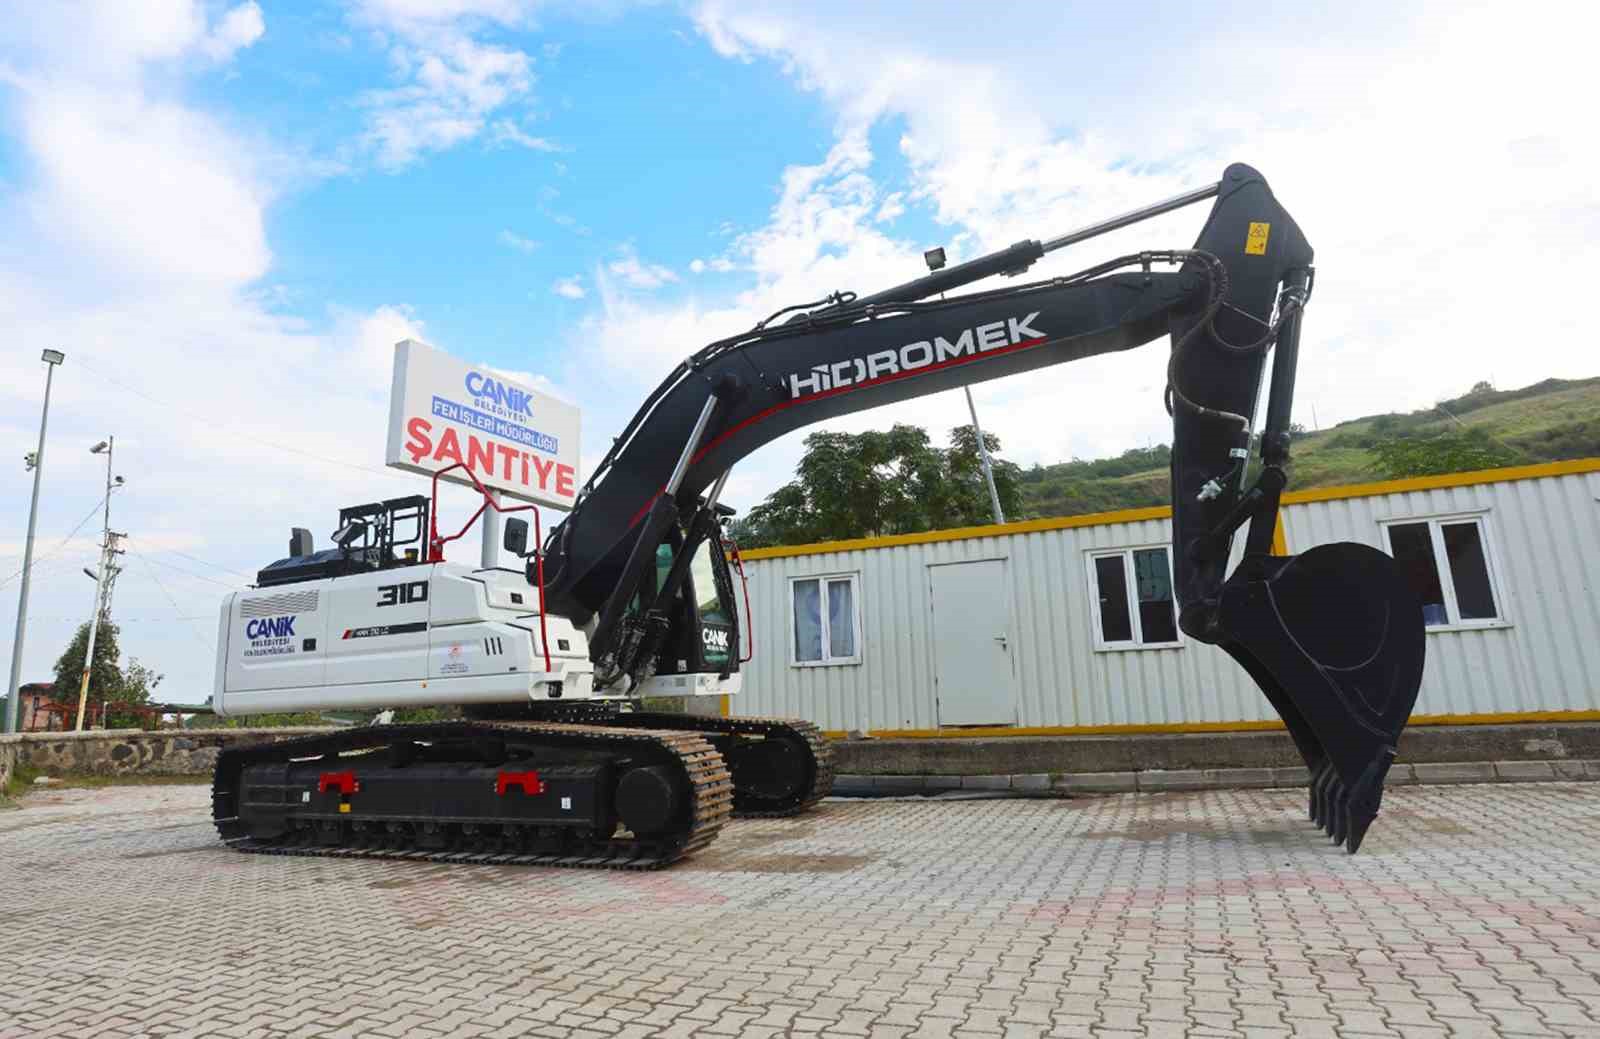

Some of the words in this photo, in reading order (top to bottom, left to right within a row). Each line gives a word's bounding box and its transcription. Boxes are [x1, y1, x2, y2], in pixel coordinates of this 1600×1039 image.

[433, 401, 458, 419] FEN
[460, 406, 495, 431] İŞLERİ
[496, 421, 557, 452] MÜDÜRLÜĞÜ
[404, 416, 576, 498] ŞANTİYE
[376, 580, 429, 607] 310
